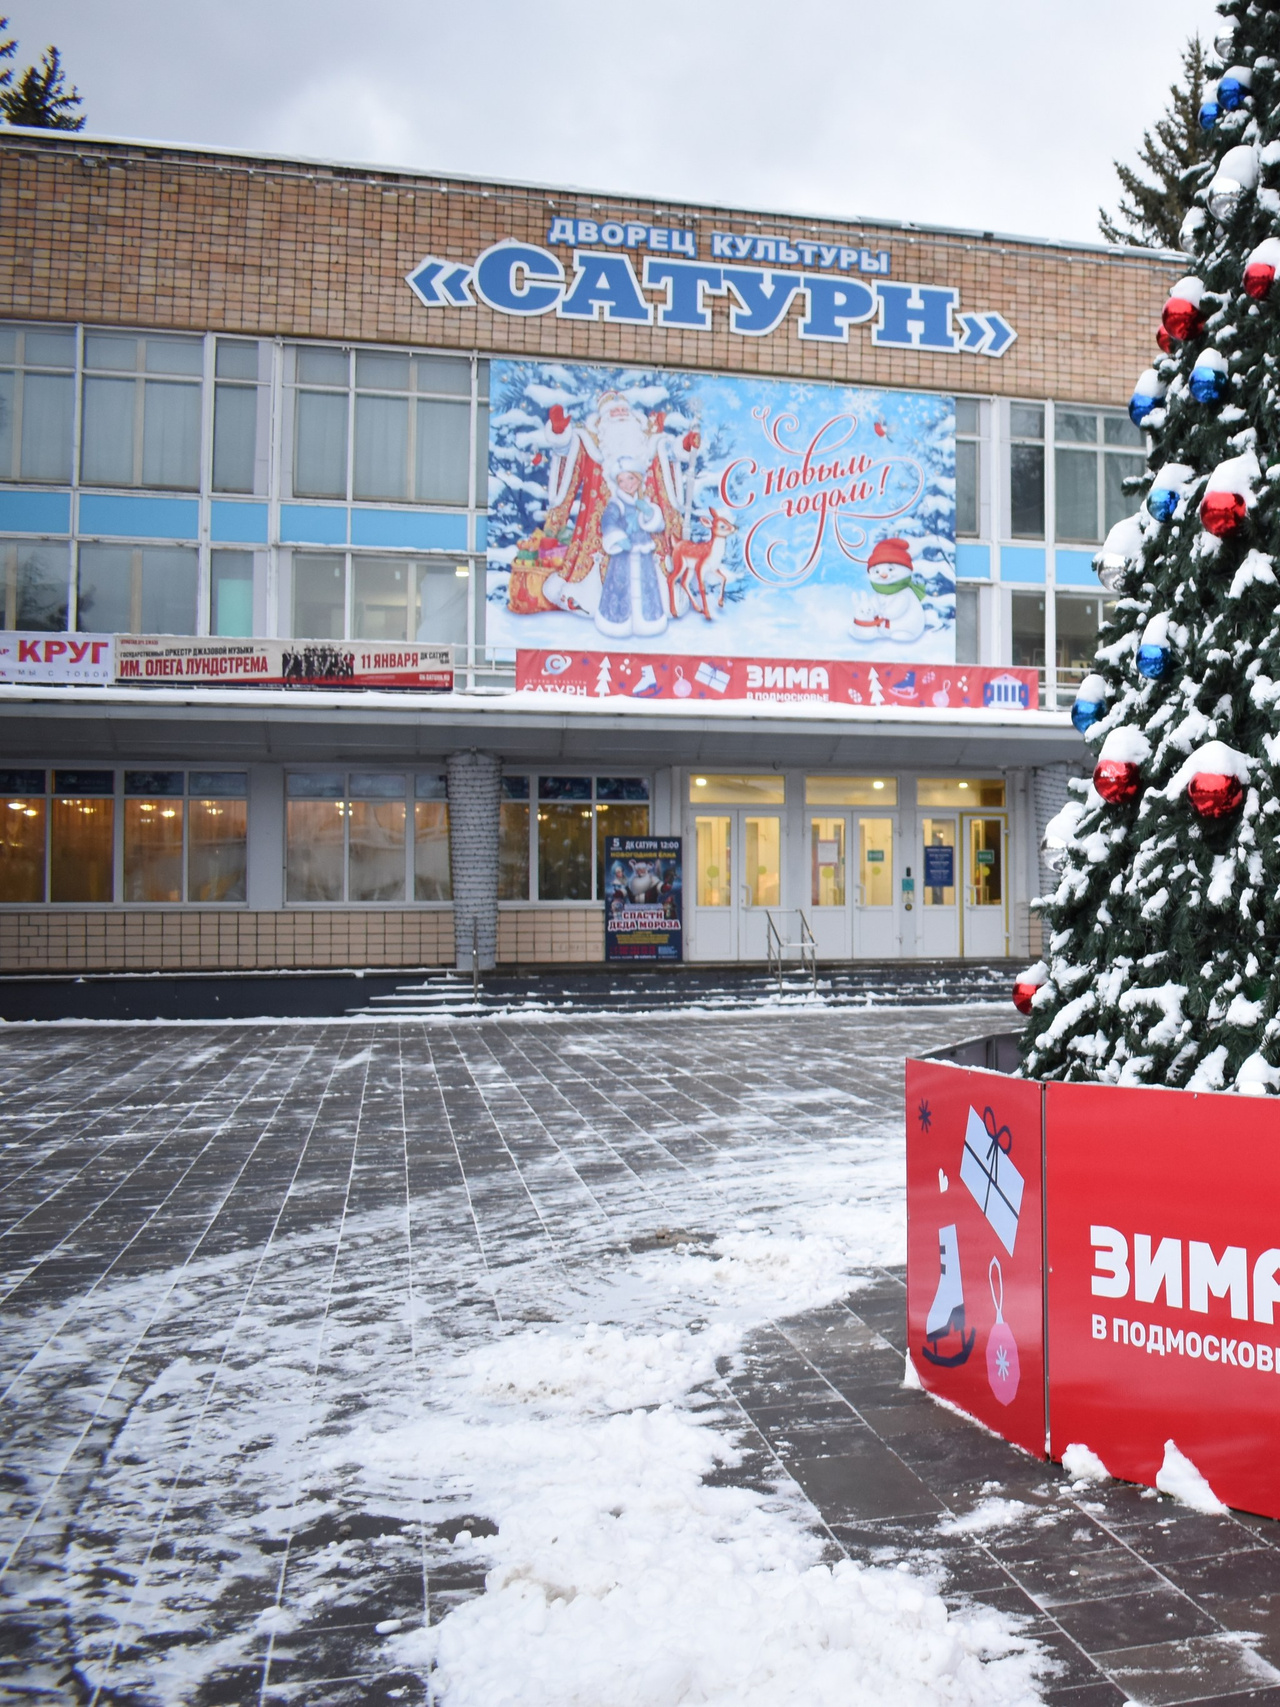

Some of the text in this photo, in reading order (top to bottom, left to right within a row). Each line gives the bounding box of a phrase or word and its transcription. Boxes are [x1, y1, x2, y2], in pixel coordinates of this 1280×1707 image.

[548, 215, 891, 275] ДВОРЕЦ КУЛЬТУРЫ
[403, 237, 1019, 358] «САТУРН»
[719, 457, 757, 510] С
[18, 640, 110, 664] КРУГ
[164, 648, 192, 657] ОРКЕСТР
[192, 646, 227, 657] ДЖАЗОВОЙ
[227, 646, 254, 655] МУЗЫКИ
[361, 652, 419, 669] 11 ЯНВАРЯ
[18, 669, 110, 678] МЫ С ТОБОЙ
[120, 656, 269, 677] ИМ. ОЛЕГА ЛУНДСТРЕМА
[746, 664, 830, 690] ЗИМА
[635, 841, 658, 849] САТУРН
[660, 841, 679, 849] 12:00
[609, 920, 680, 930] ДЕДА МОРОЗА
[623, 911, 663, 919] СПАСТИ
[1092, 1313, 1107, 1340] В
